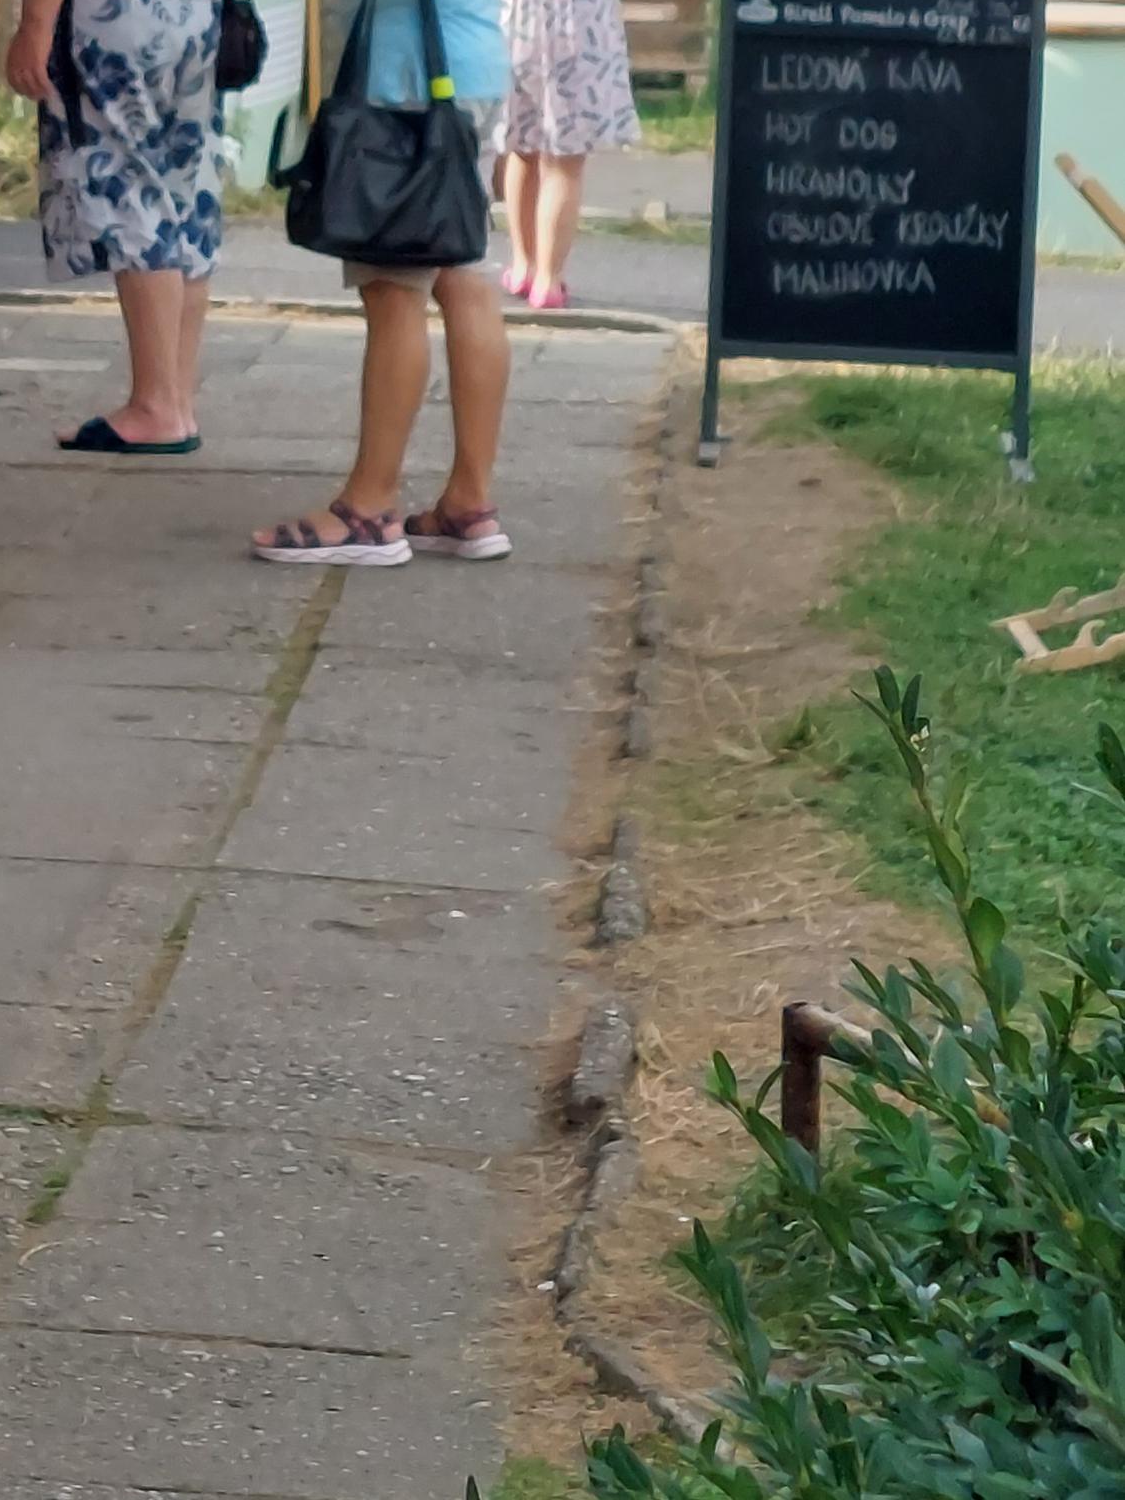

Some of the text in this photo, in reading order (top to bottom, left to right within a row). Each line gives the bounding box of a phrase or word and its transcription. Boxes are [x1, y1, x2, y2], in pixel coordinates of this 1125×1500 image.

[761, 47, 962, 93] LEDOVÁ KÁVA
[765, 110, 898, 150] HOT DOG
